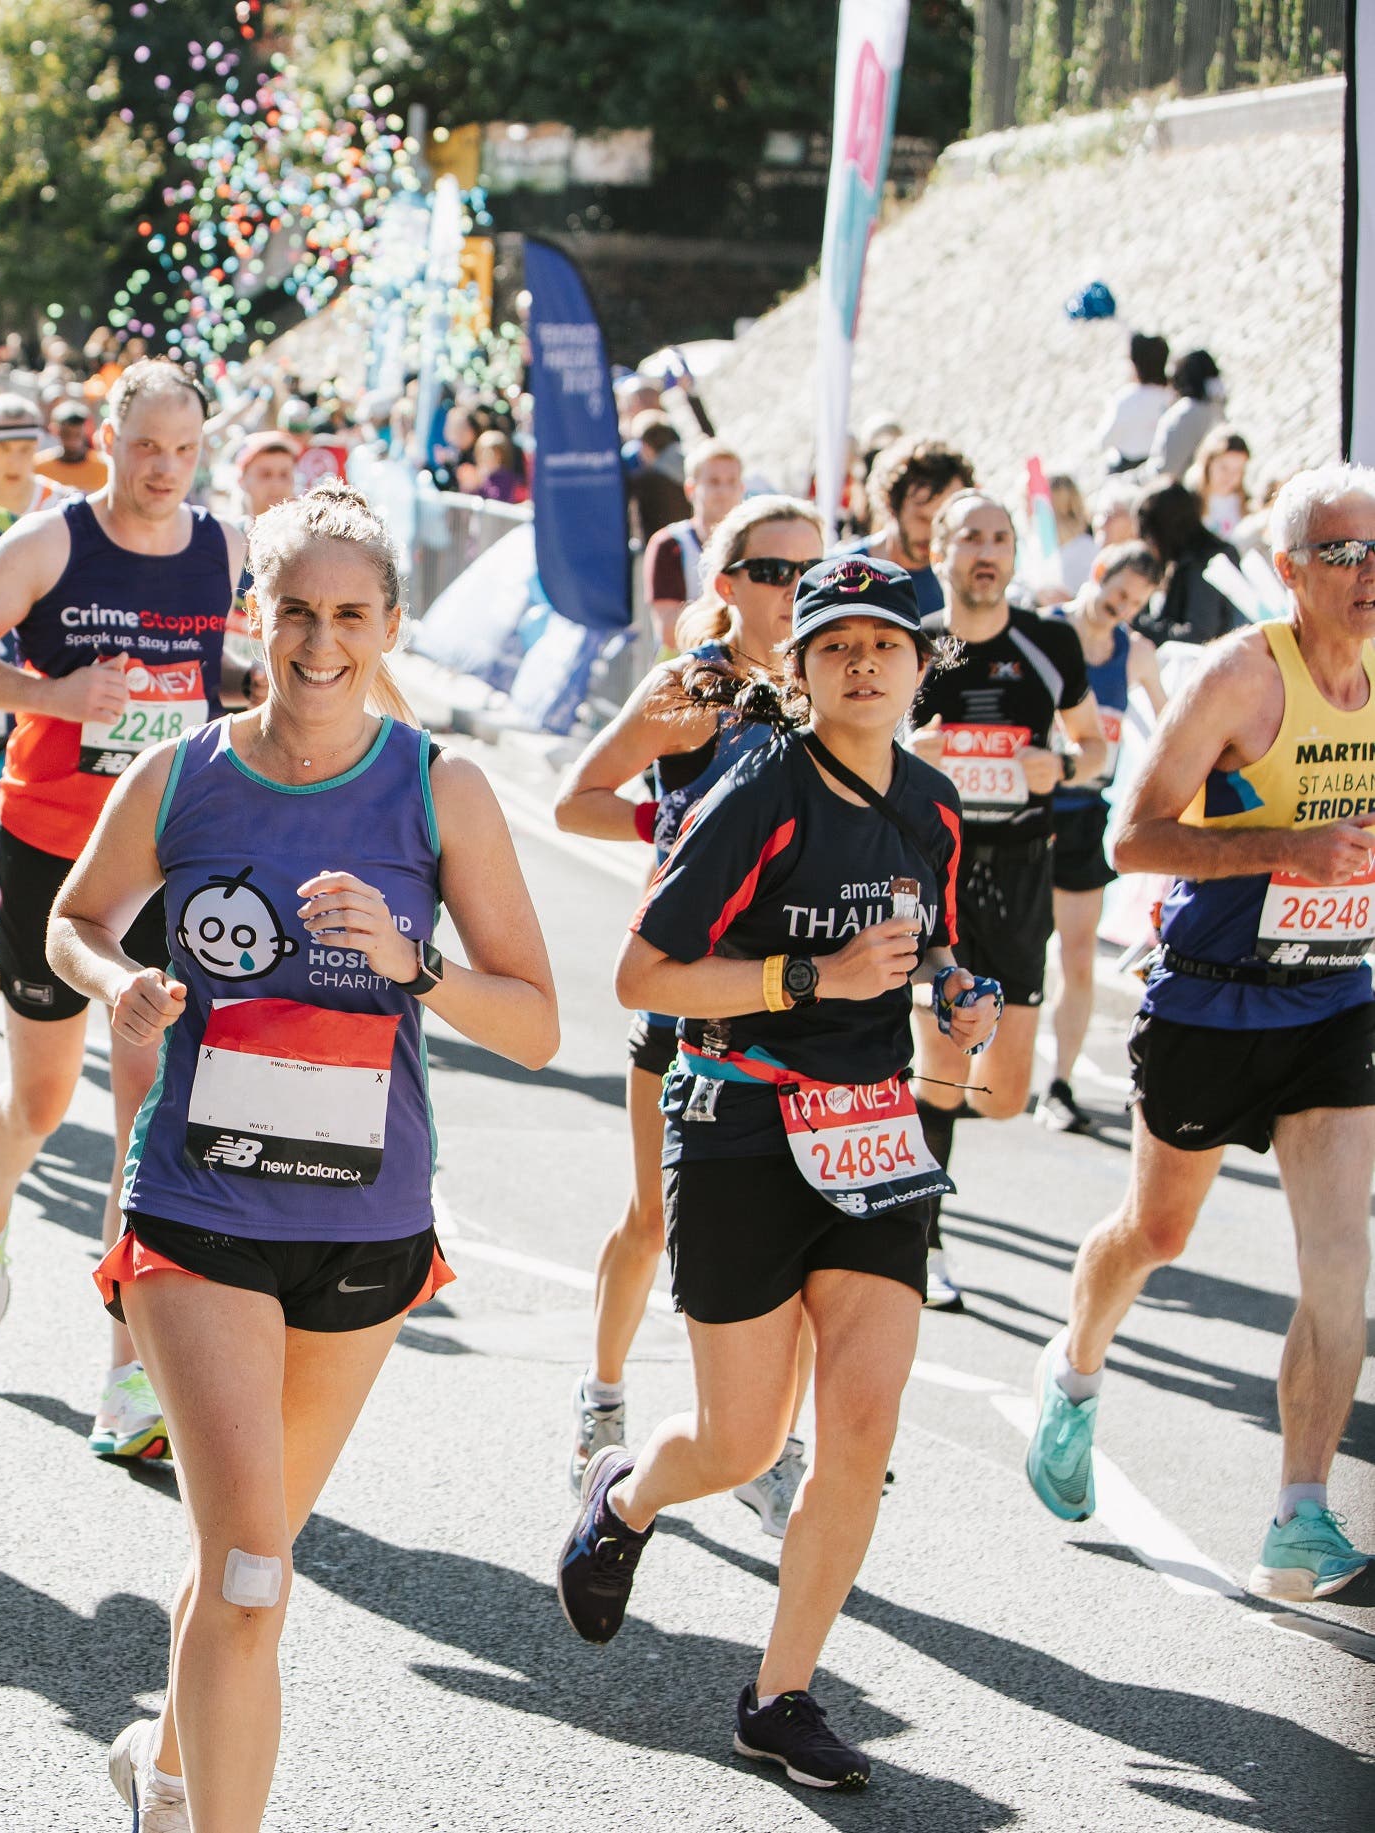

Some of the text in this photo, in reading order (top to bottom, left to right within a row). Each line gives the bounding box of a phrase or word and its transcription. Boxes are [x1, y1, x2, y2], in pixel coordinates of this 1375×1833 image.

[65, 632, 111, 647] Speak
[113, 635, 135, 647] up.
[138, 636, 170, 653] Stay
[108, 711, 183, 742] 2248
[944, 765, 1015, 793] 5833
[1298, 774, 1320, 796] ST
[1278, 896, 1370, 929] 26248
[1306, 955, 1328, 966] new
[309, 970, 392, 990] CHARITY
[270, 1061, 323, 1073] #WeRunTogether
[249, 1122, 269, 1131] WAVE
[315, 1130, 330, 1138] BAG
[811, 1130, 916, 1181] 24854
[260, 1159, 294, 1174] new
[870, 1198, 896, 1211] new
